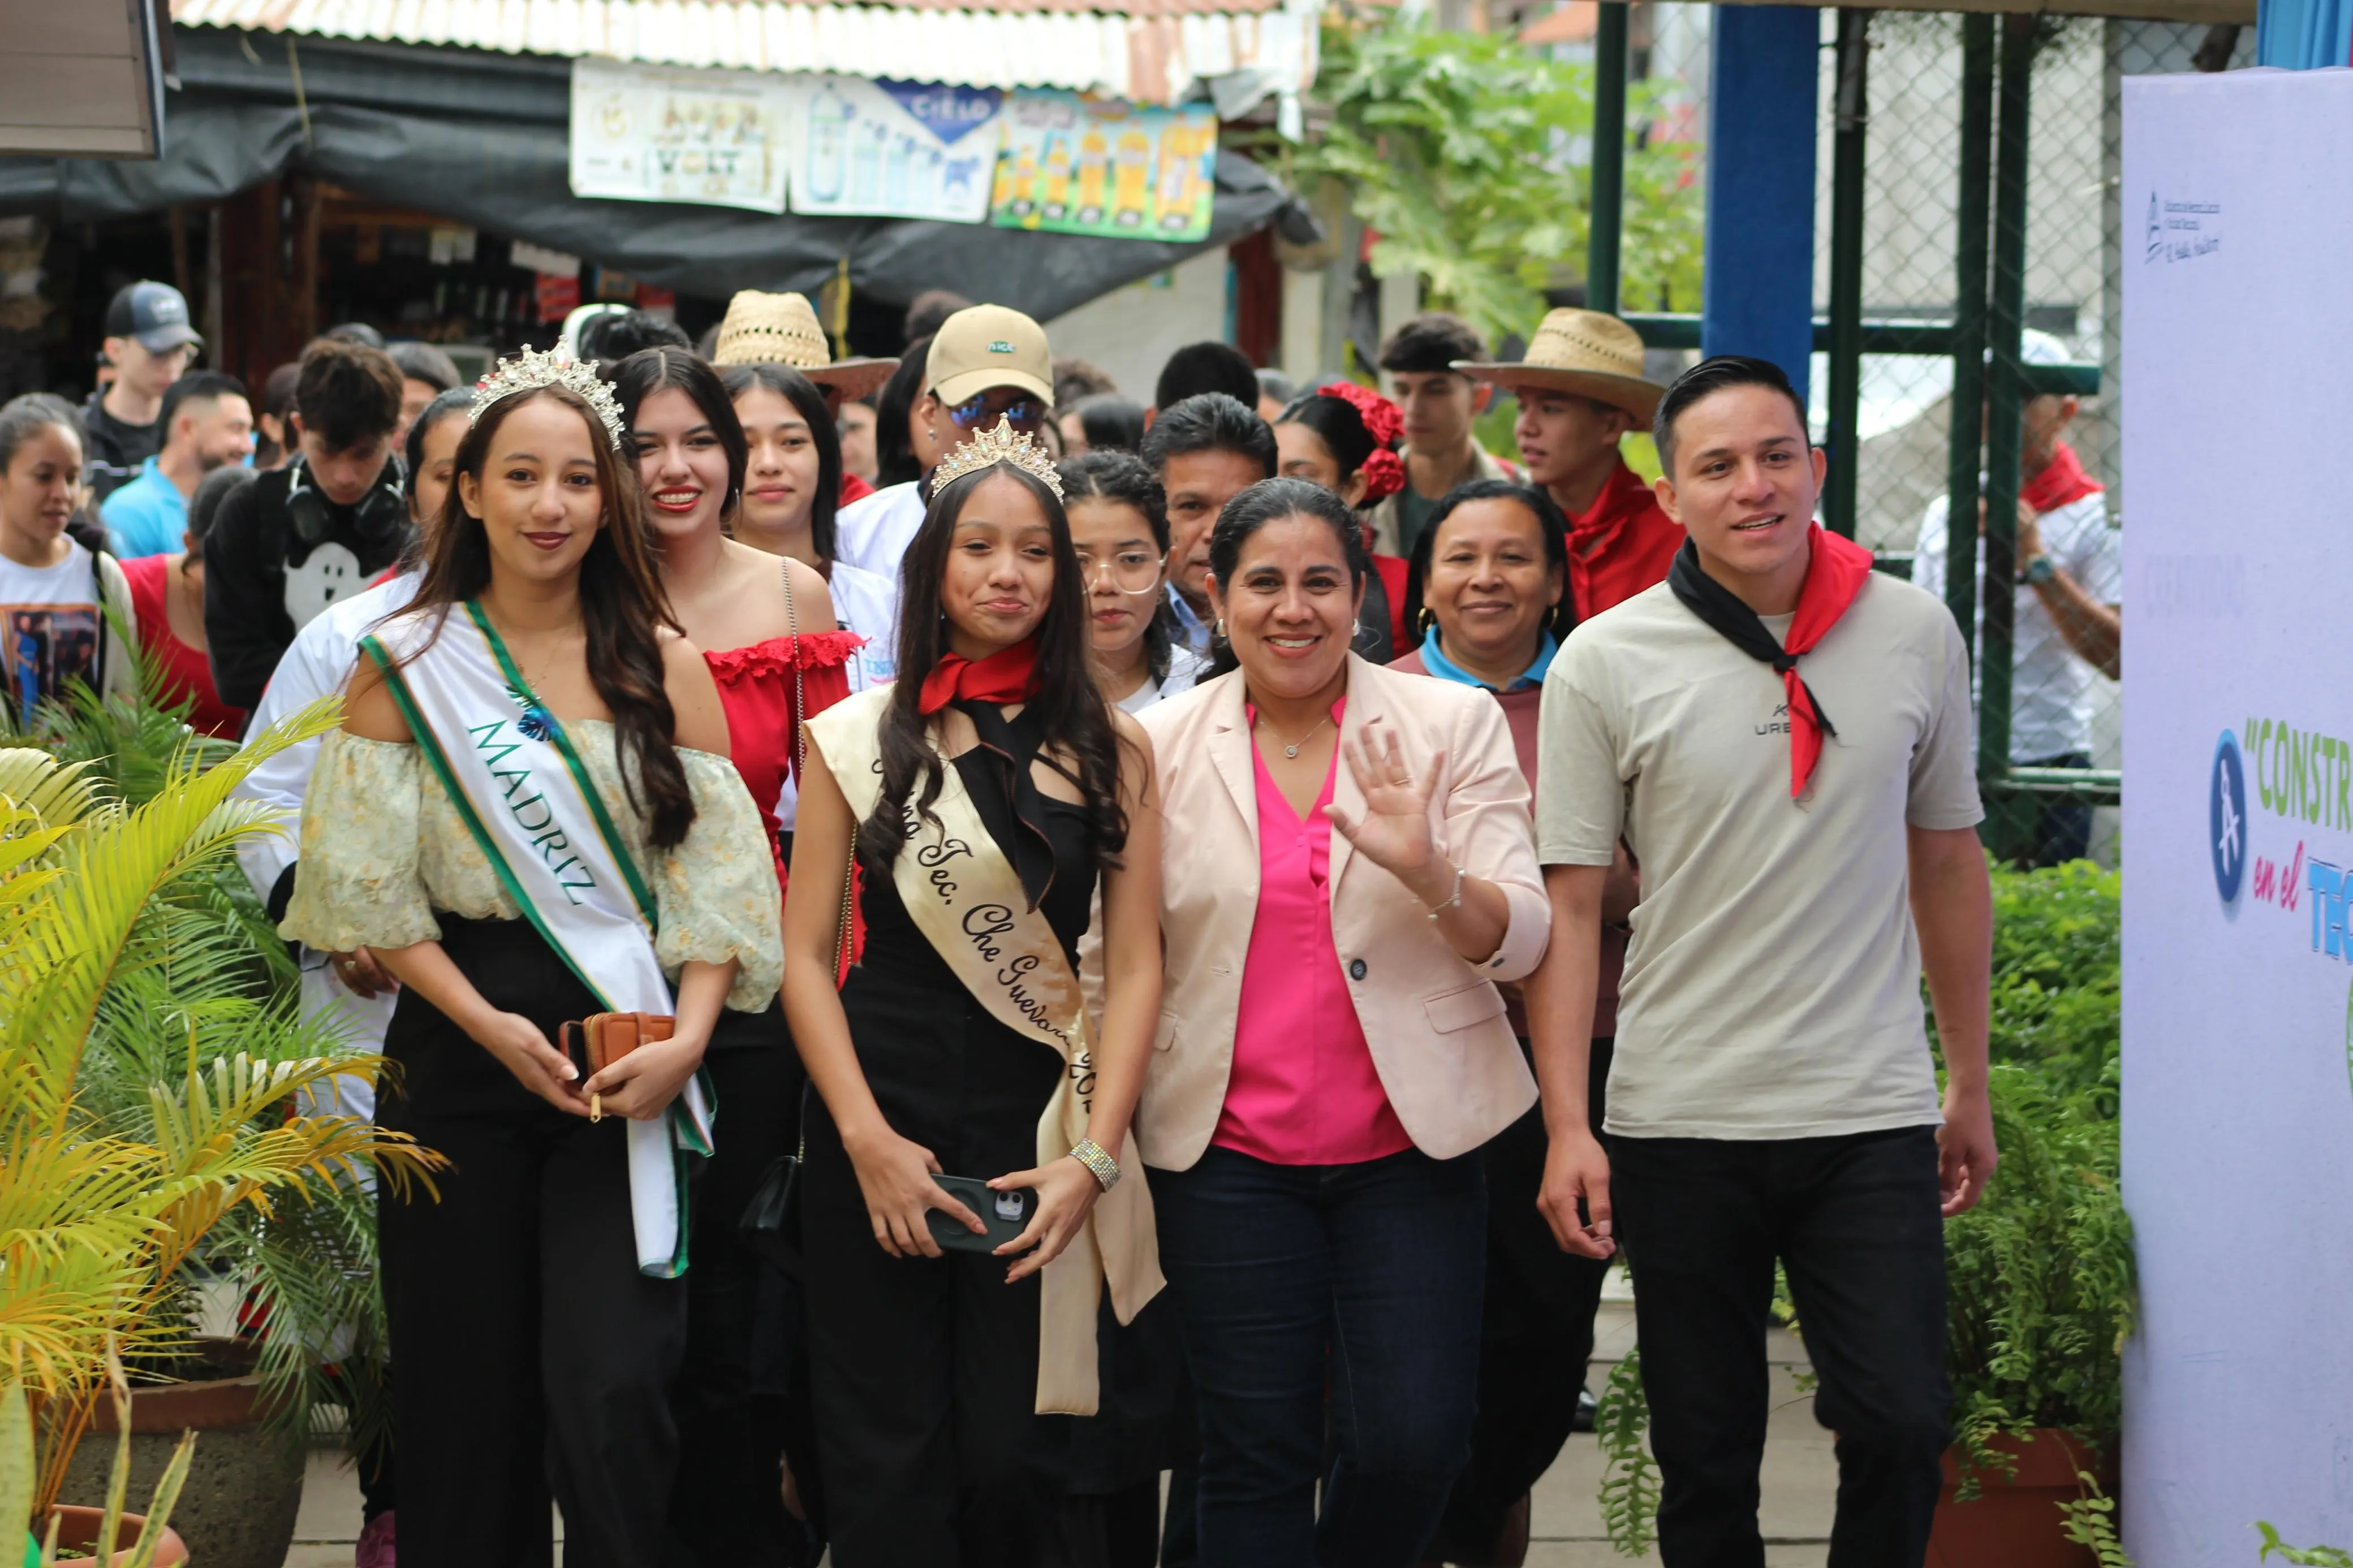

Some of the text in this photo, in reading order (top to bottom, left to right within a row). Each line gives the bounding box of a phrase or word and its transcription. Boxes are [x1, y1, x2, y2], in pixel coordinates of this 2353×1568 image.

[468, 719, 597, 906] MADRIZ
[2244, 716, 2353, 835] "CONSTR
[2254, 854, 2276, 904] en
[2281, 839, 2303, 912] el
[962, 903, 1015, 962] Che
[997, 954, 1070, 1047] Guevar
